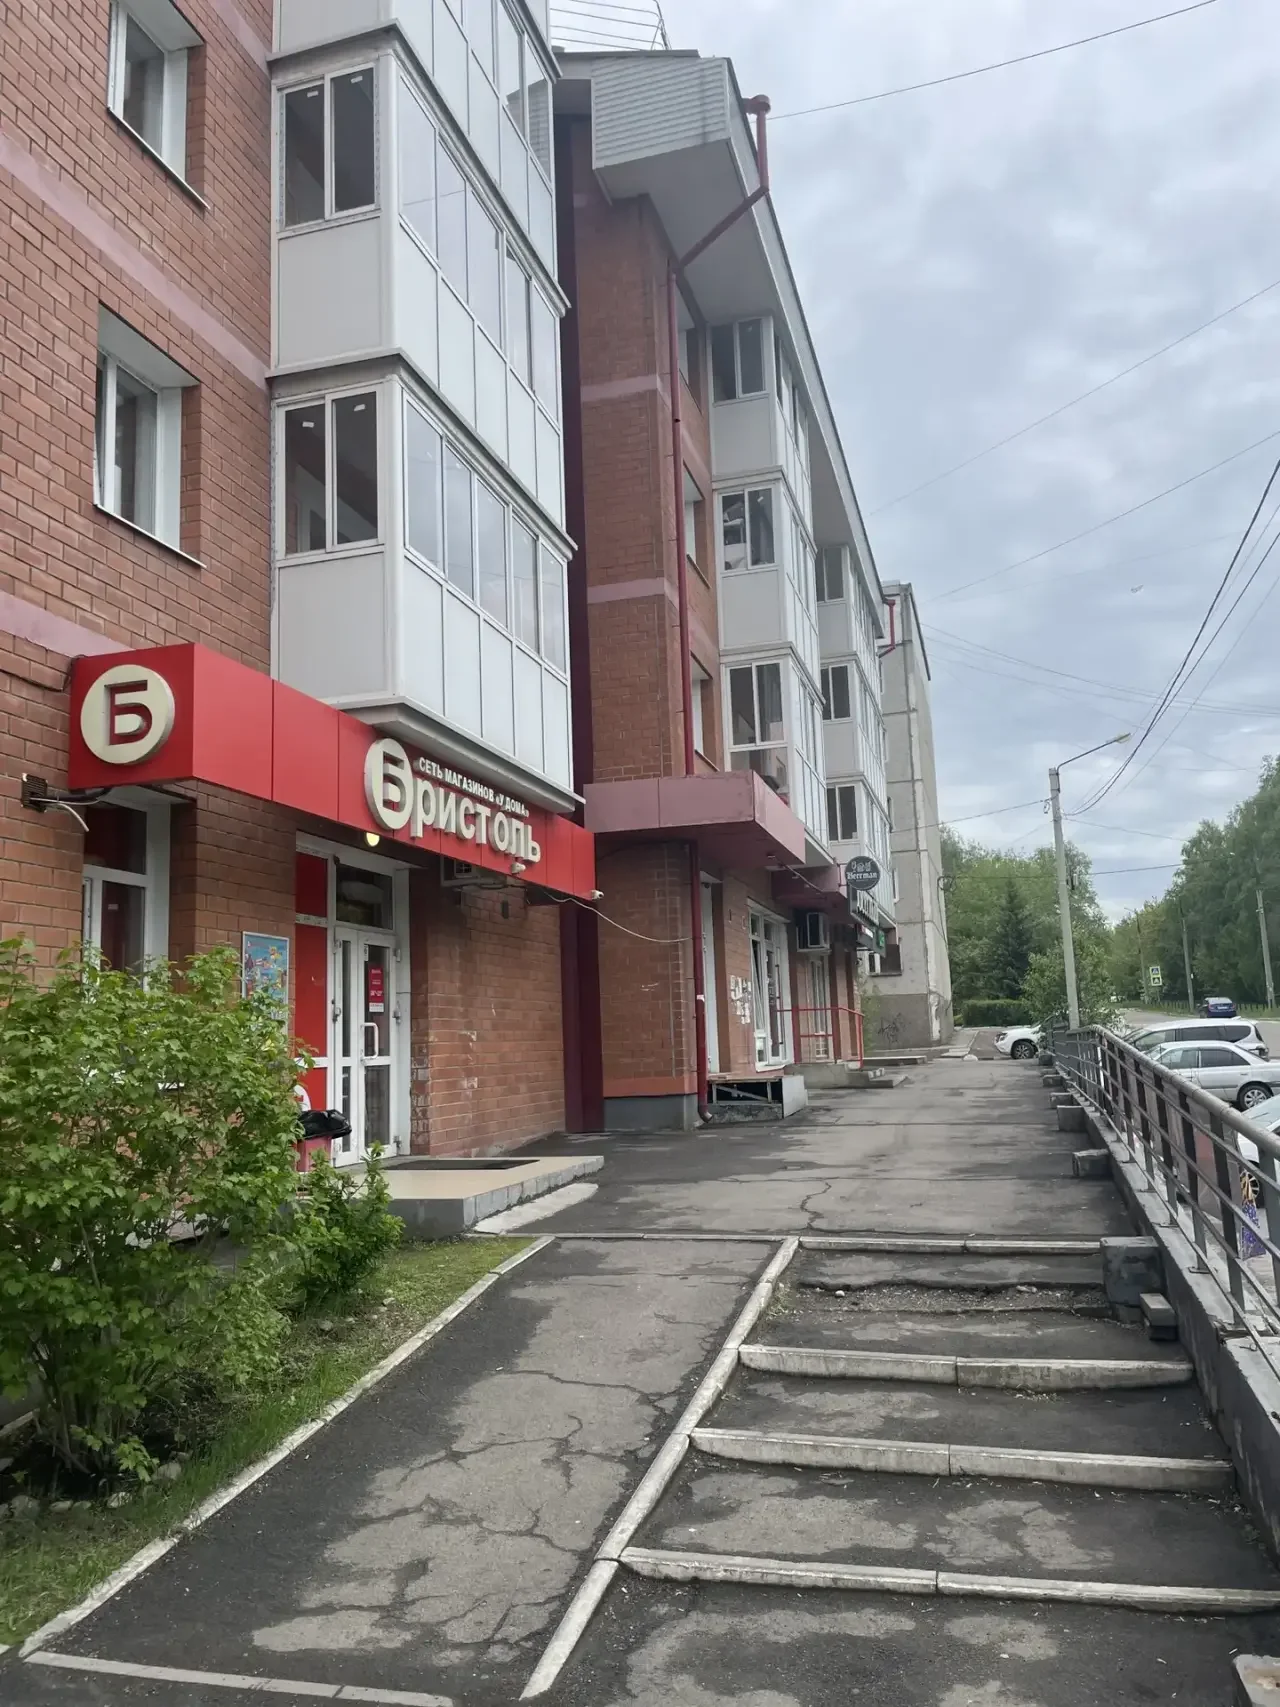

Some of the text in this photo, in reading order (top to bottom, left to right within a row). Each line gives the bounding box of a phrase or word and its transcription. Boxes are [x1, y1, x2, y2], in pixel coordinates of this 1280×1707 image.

[104, 679, 153, 746] Б
[365, 739, 541, 863] Бристоль
[418, 757, 443, 778] СЕТЬ
[444, 768, 495, 803] МАГАЗИНОВ
